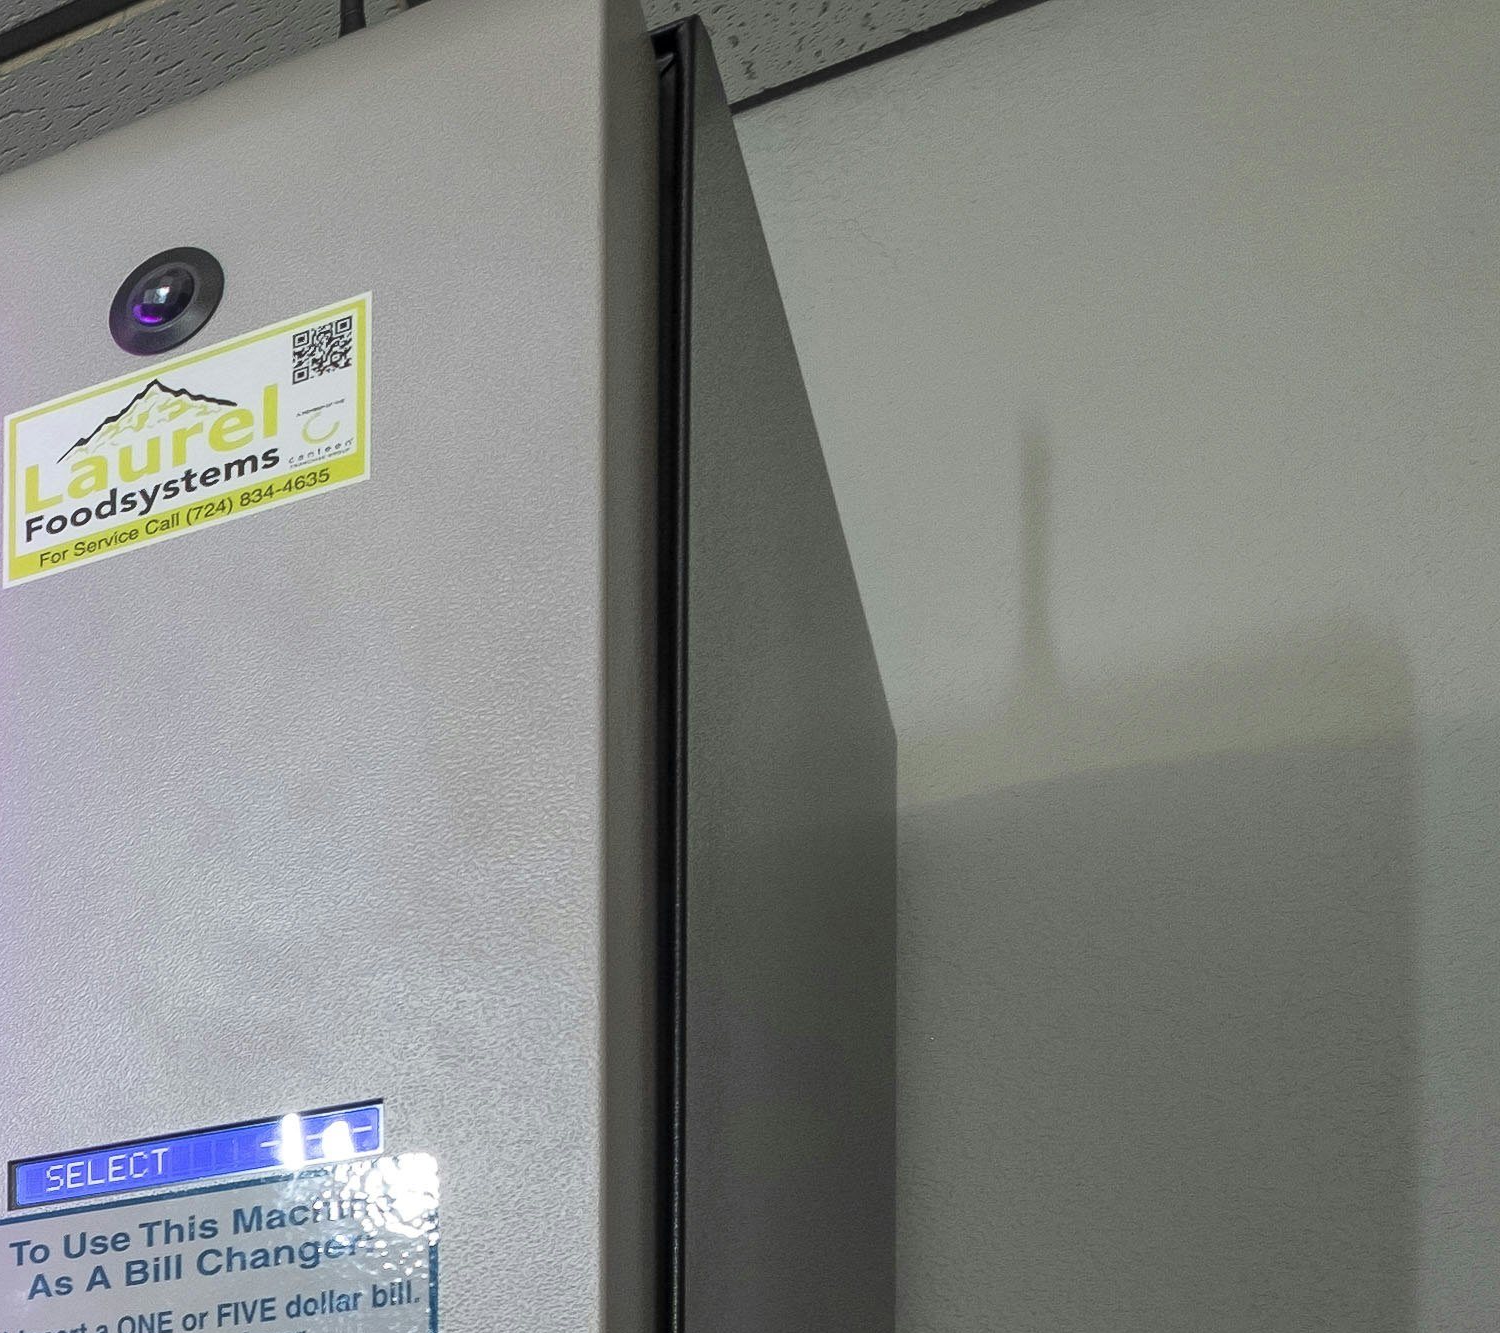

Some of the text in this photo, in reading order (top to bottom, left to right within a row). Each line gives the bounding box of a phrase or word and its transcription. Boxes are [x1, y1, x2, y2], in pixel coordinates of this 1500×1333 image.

[25, 384, 278, 513] Laurel
[25, 448, 280, 542] Foodsystems
[39, 467, 331, 568] For Service Call (724) 834-4635
[45, 1147, 170, 1194] SELECT
[10, 1240, 51, 1267] To
[63, 1228, 132, 1260] Use
[139, 1215, 220, 1249] This
[27, 1232, 371, 1300] As A Bill Changer
[182, 1312, 209, 1332] or
[216, 1298, 277, 1328] FIVE
[285, 1289, 362, 1320] dollar
[371, 1281, 421, 1310] bill.
